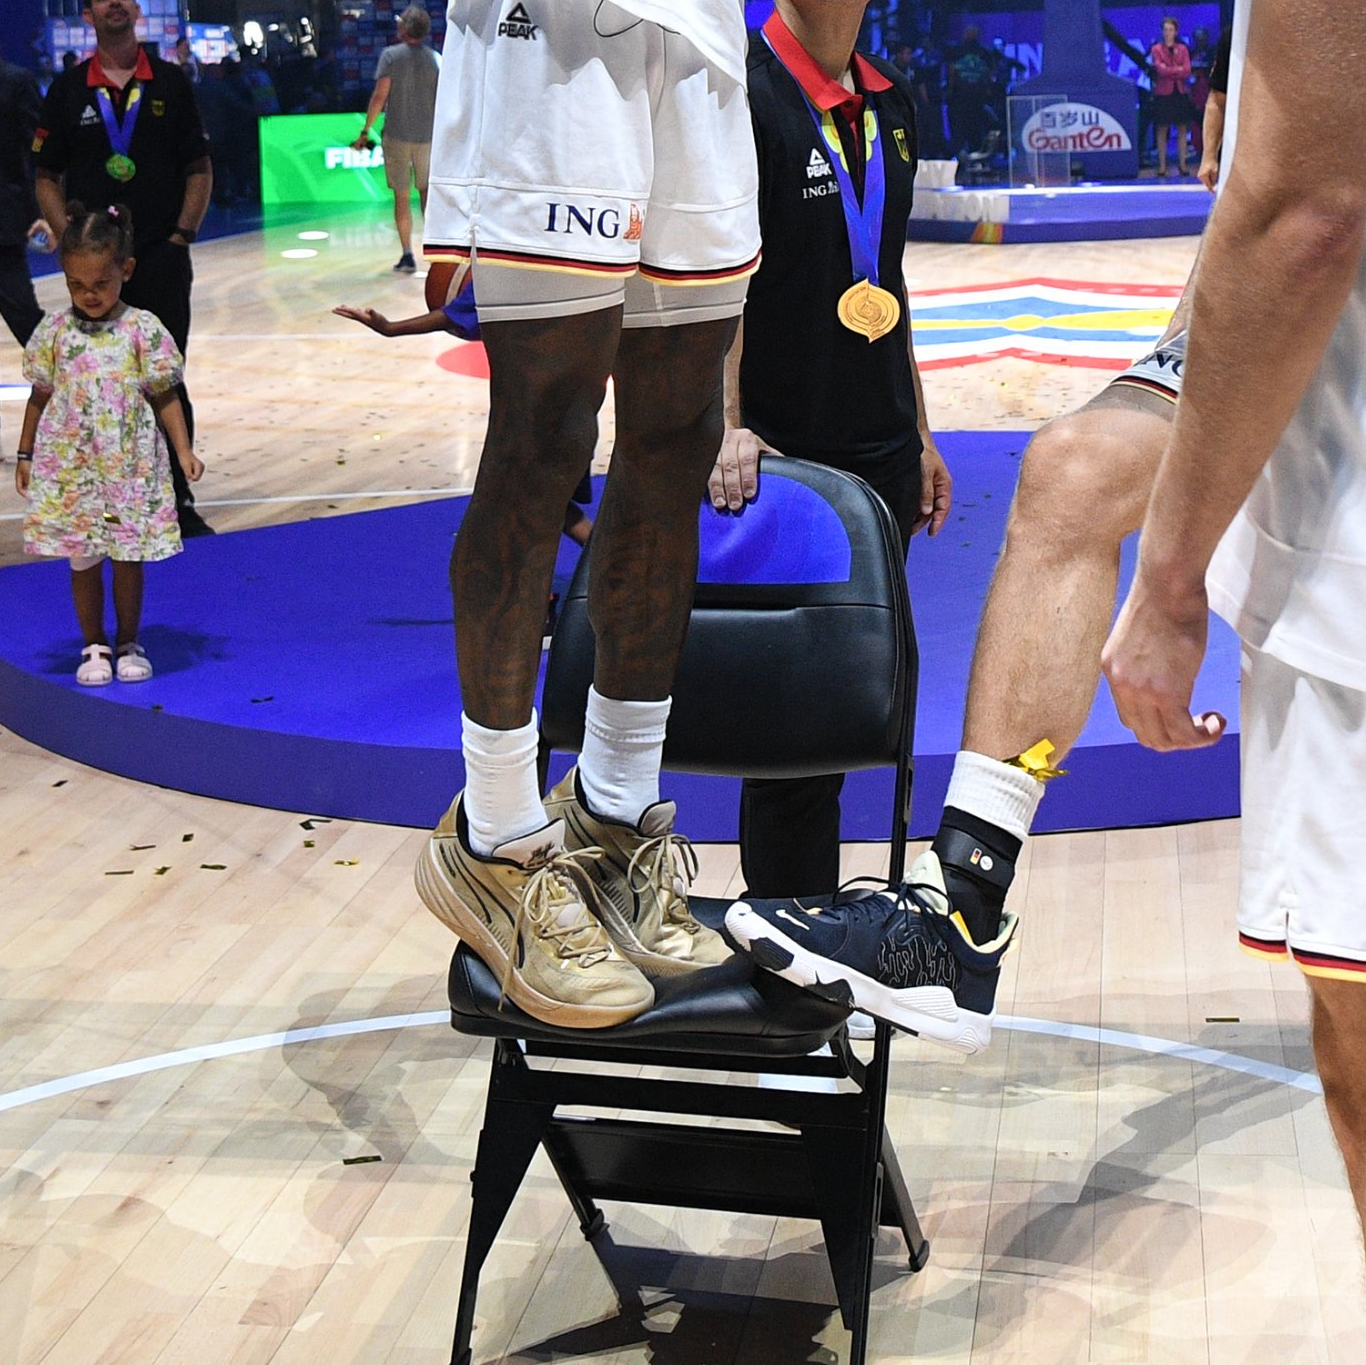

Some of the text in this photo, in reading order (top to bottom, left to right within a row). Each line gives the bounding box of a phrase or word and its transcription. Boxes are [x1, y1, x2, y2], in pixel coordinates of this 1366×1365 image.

[498, 22, 537, 41] PEAK
[806, 163, 832, 179] PEAK
[802, 185, 827, 200] ING
[543, 202, 621, 239] ING
